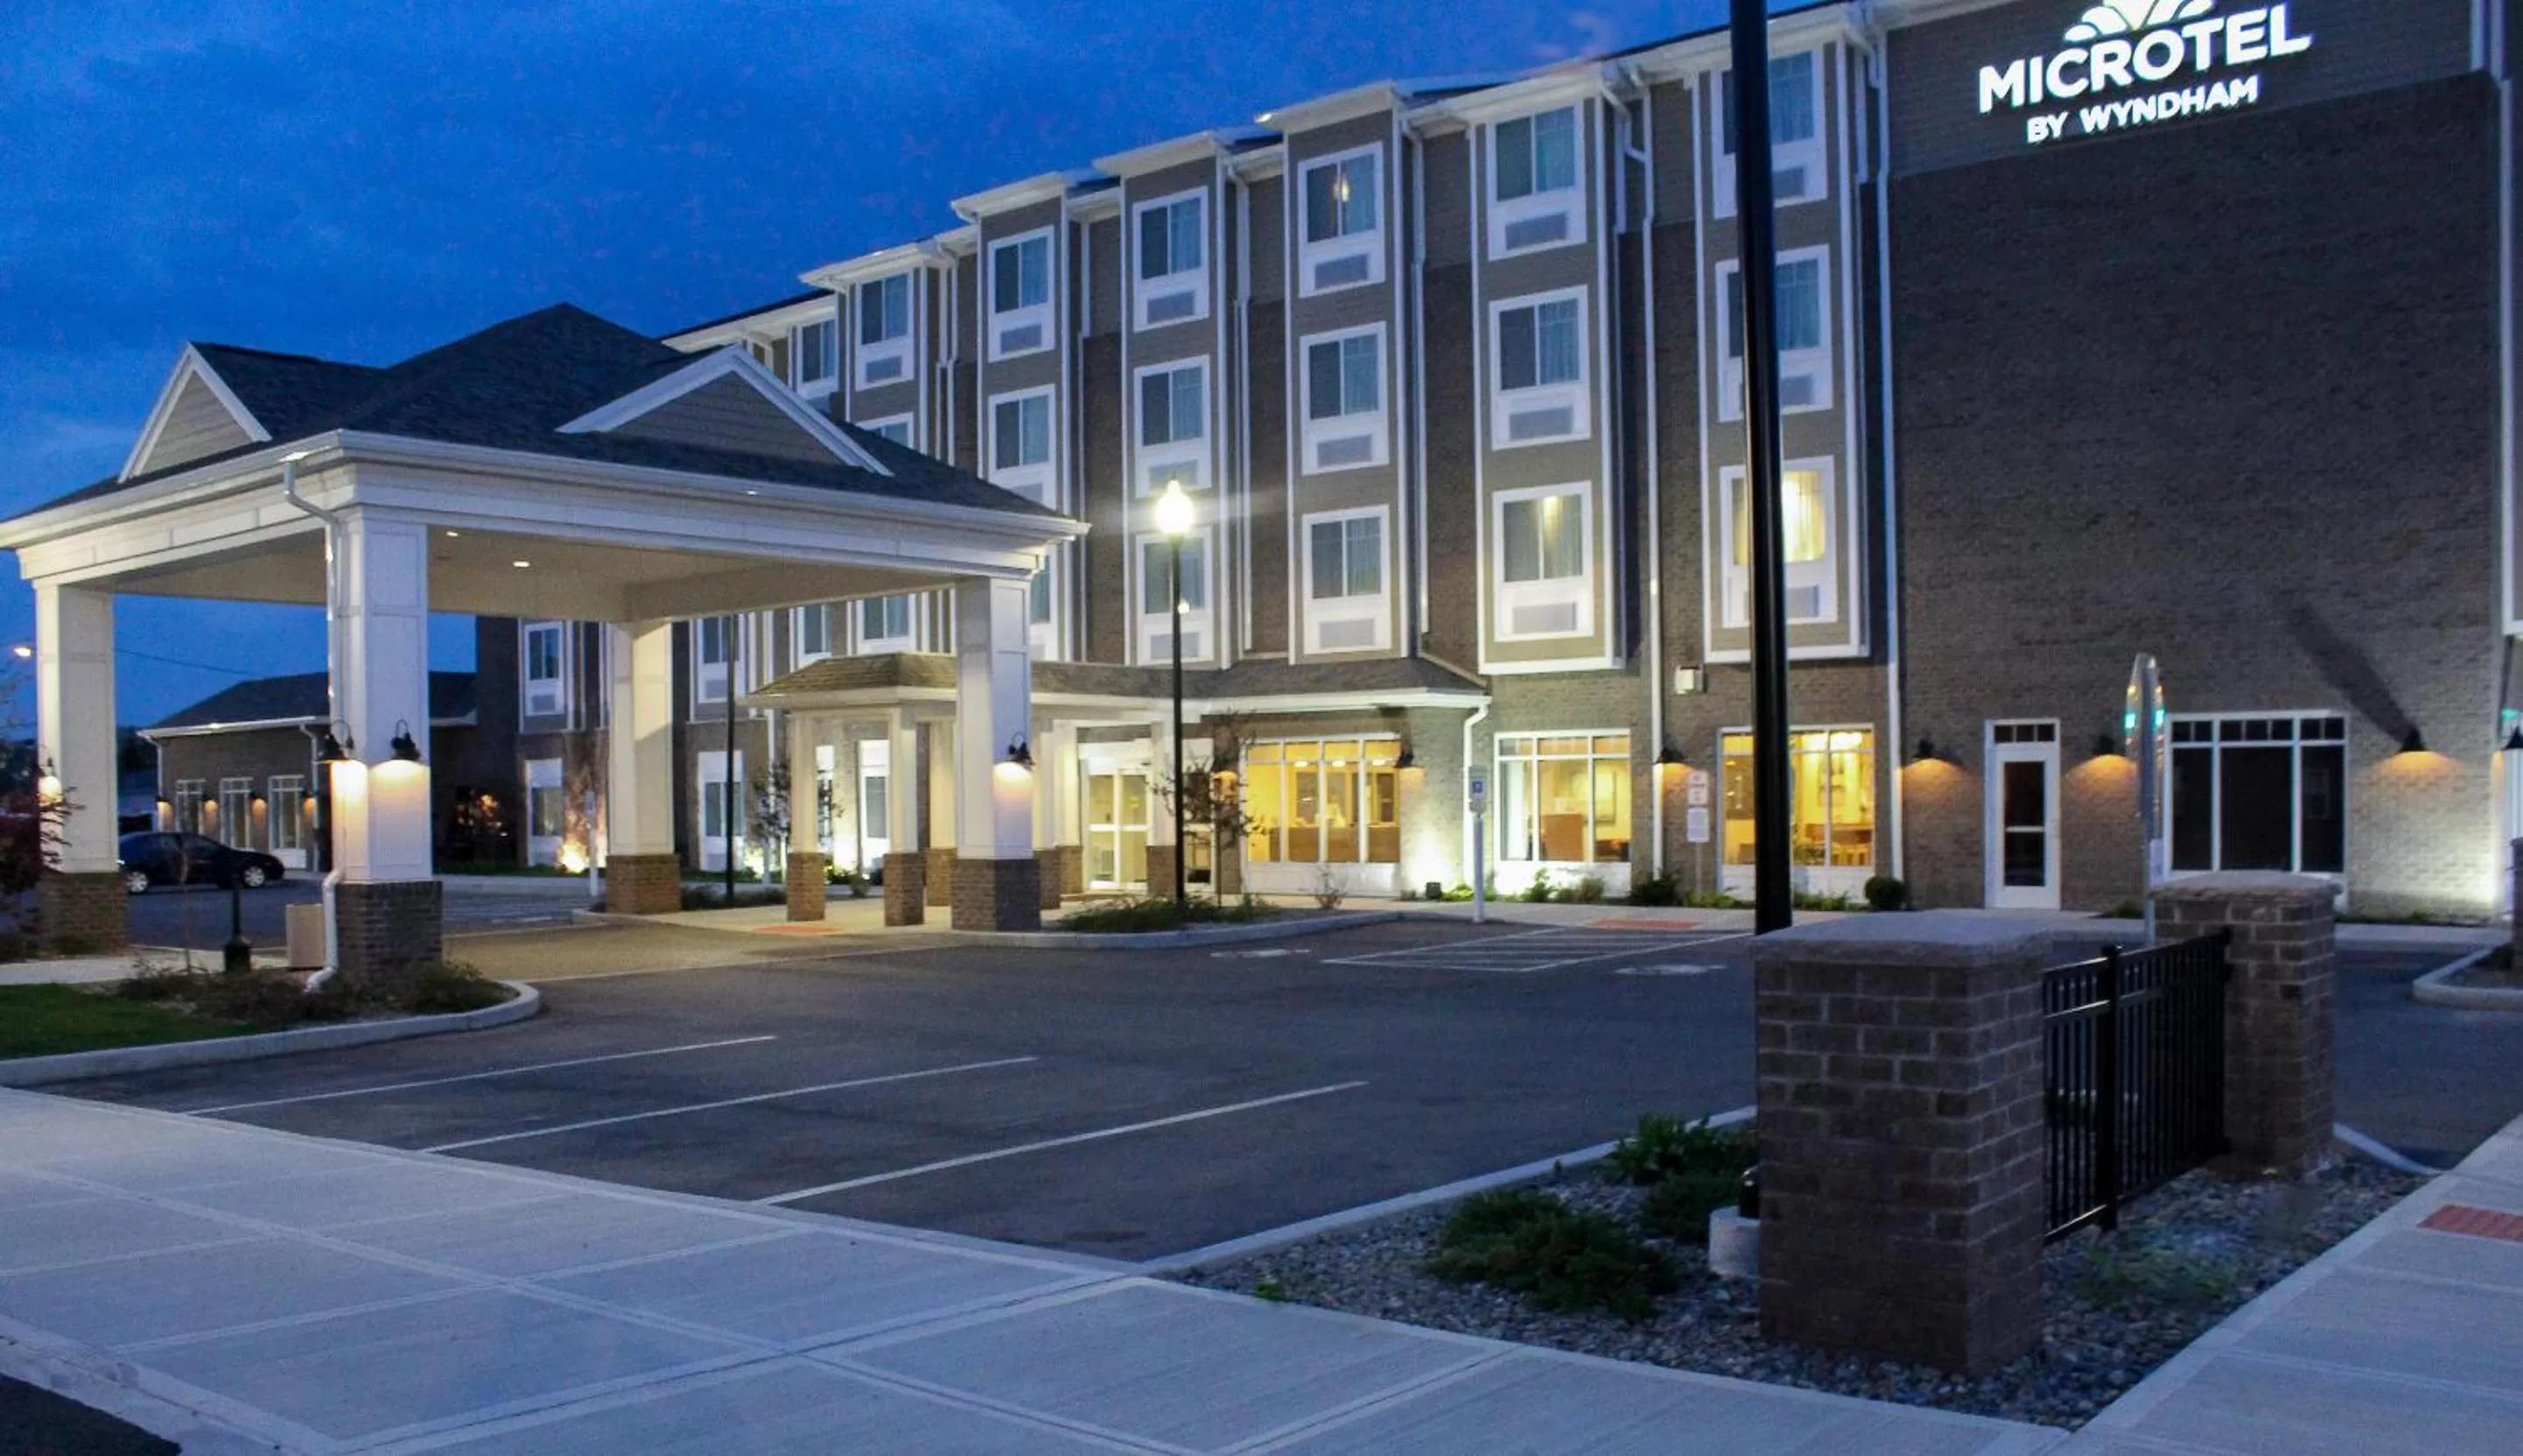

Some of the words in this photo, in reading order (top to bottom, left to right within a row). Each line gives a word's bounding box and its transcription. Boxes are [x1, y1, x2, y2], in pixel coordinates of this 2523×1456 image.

[1979, 4, 2312, 113] MICROTEL
[2027, 111, 2068, 143] BY
[2080, 75, 2258, 133] WYNDHAM
